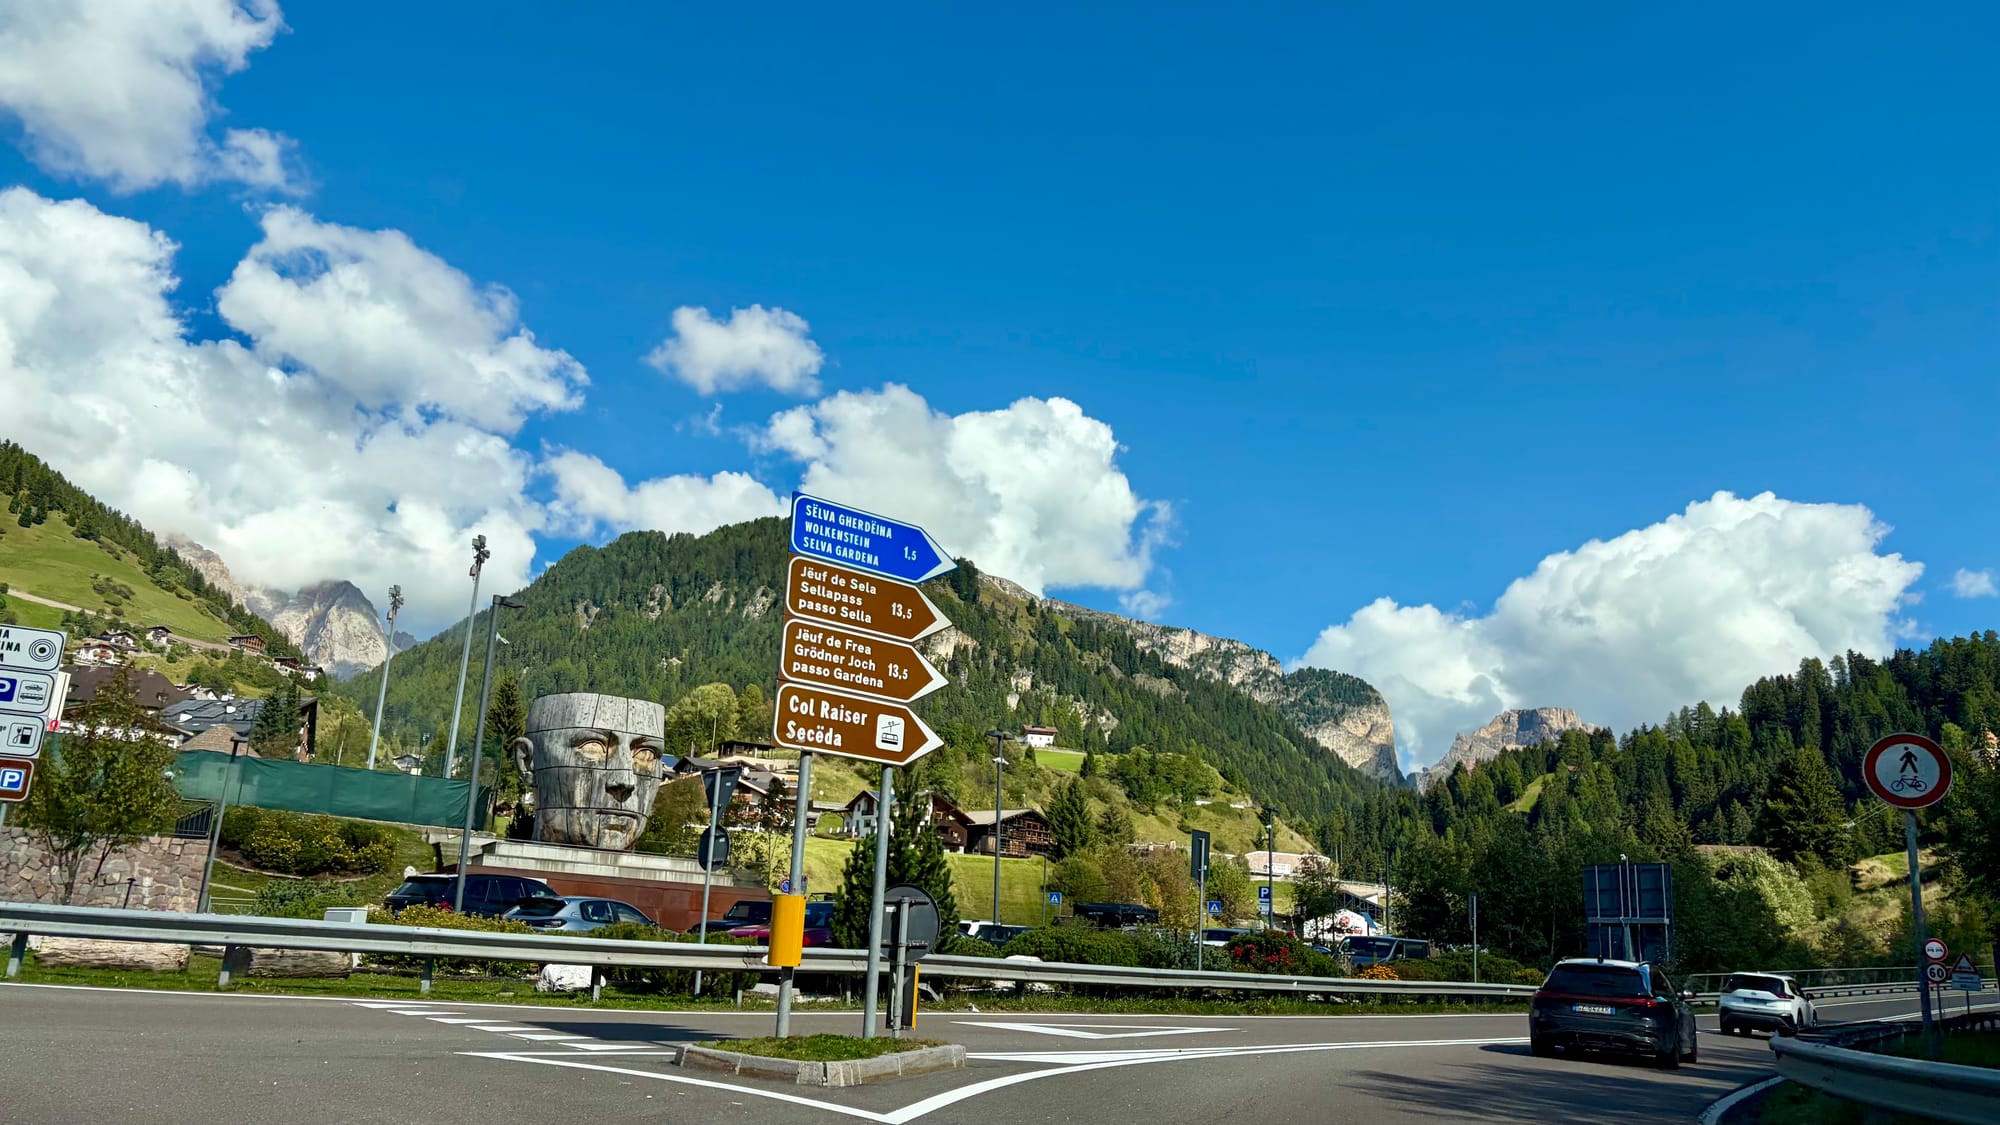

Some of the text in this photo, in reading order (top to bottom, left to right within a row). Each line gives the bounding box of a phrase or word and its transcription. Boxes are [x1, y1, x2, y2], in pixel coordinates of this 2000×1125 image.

[804, 520, 871, 549] WOLKENSTEIN
[805, 503, 893, 540] SËLVA GHERDËINA
[803, 536, 879, 567] SELVA GARDENA
[800, 566, 877, 595] Jëuf de Sela
[800, 581, 863, 606] Sellapass
[798, 598, 872, 624] passo Sella
[795, 628, 872, 655] Jëuf de Frea
[794, 643, 876, 672] Grödner Joch
[792, 661, 884, 688] passo Gardena
[789, 694, 868, 726] Col Raiser
[786, 720, 842, 747] Secëda
[2, 771, 20, 787] P
[1260, 887, 1270, 898] P
[1928, 967, 1945, 979] 60
